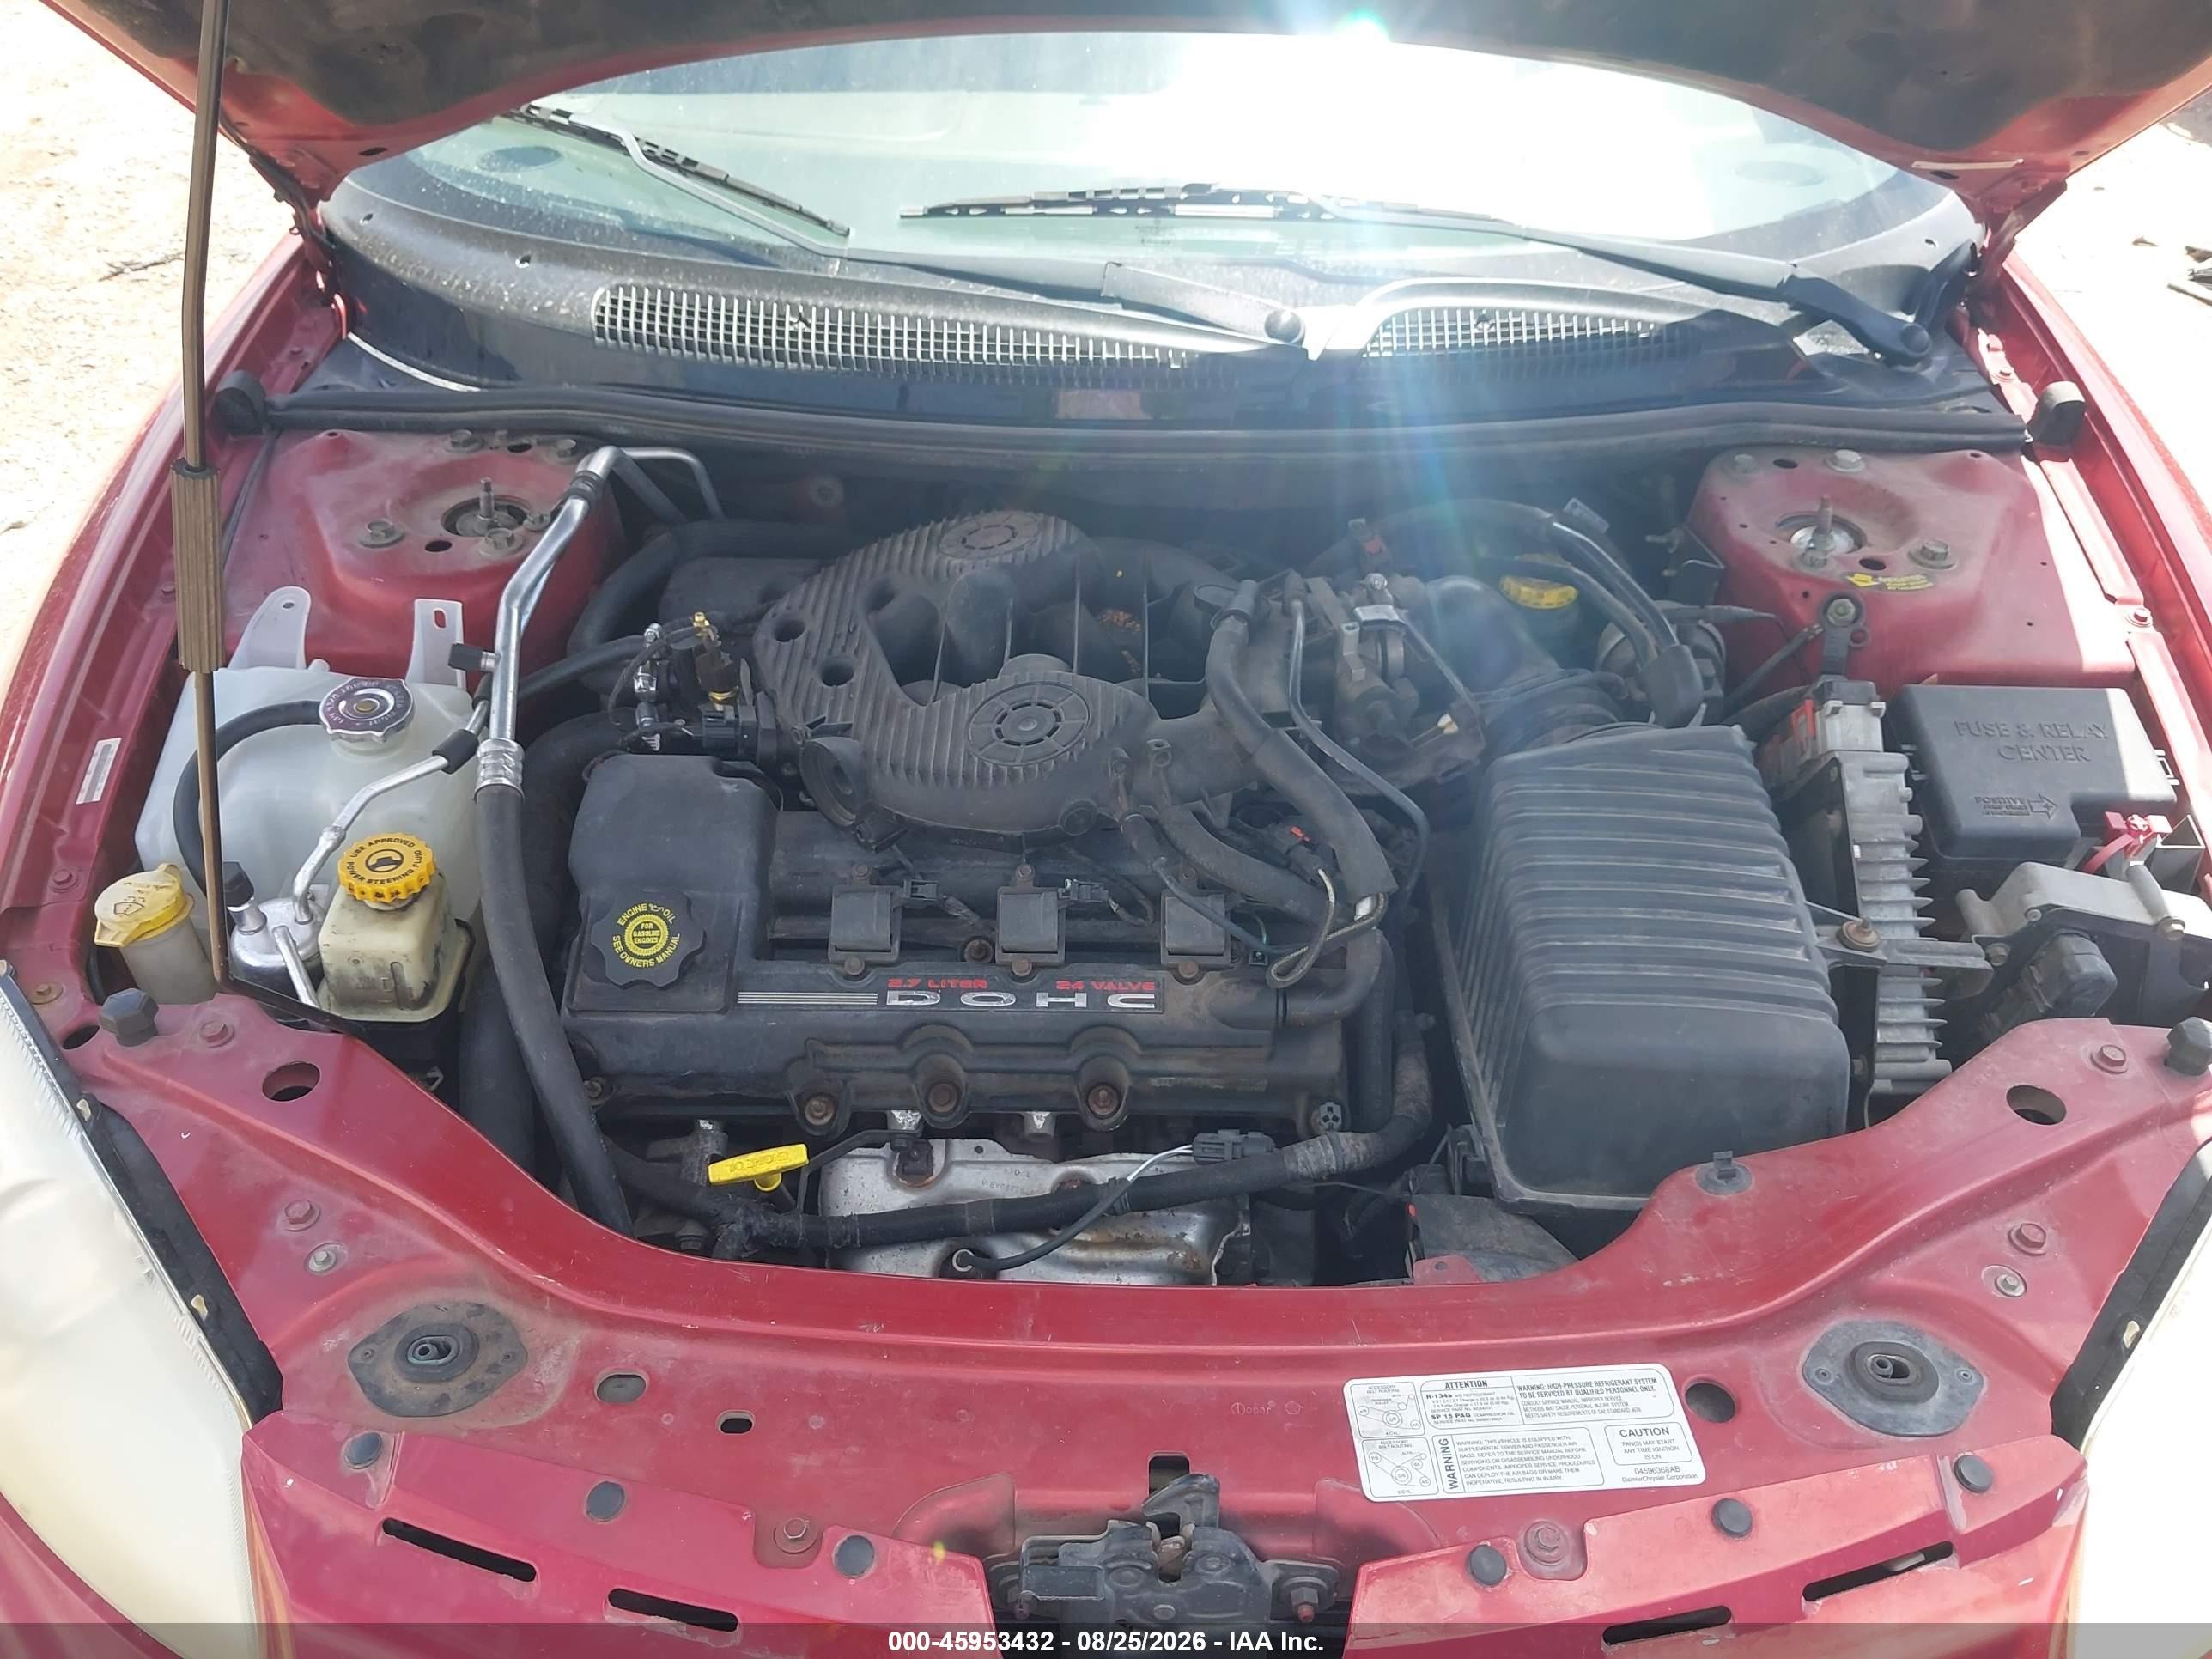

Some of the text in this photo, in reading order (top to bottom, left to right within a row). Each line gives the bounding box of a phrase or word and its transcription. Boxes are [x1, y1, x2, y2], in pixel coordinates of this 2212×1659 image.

[1954, 720, 2108, 738] FUSE & RELAY
[1997, 744, 2092, 762] CENTER
[349, 837, 416, 858] USE APPROVED
[412, 850, 422, 868] FLUID
[346, 861, 415, 884] POWER STEERING
[617, 903, 676, 926] ENGINE OIL
[633, 929, 660, 938] GASOLINE
[612, 933, 681, 968] SEE OWNERS MANUAL
[927, 979, 988, 989] LITER
[1055, 981, 1078, 990] 24
[1090, 981, 1156, 991] VALVE
[886, 990, 1156, 1008] DOHC
[1445, 1380, 1488, 1389] ATTENTION
[1620, 1427, 1669, 1437] CAUTION
[1438, 1438, 1459, 1489] WARNING
[1621, 1474, 1665, 1483] DaimlerChrysler
